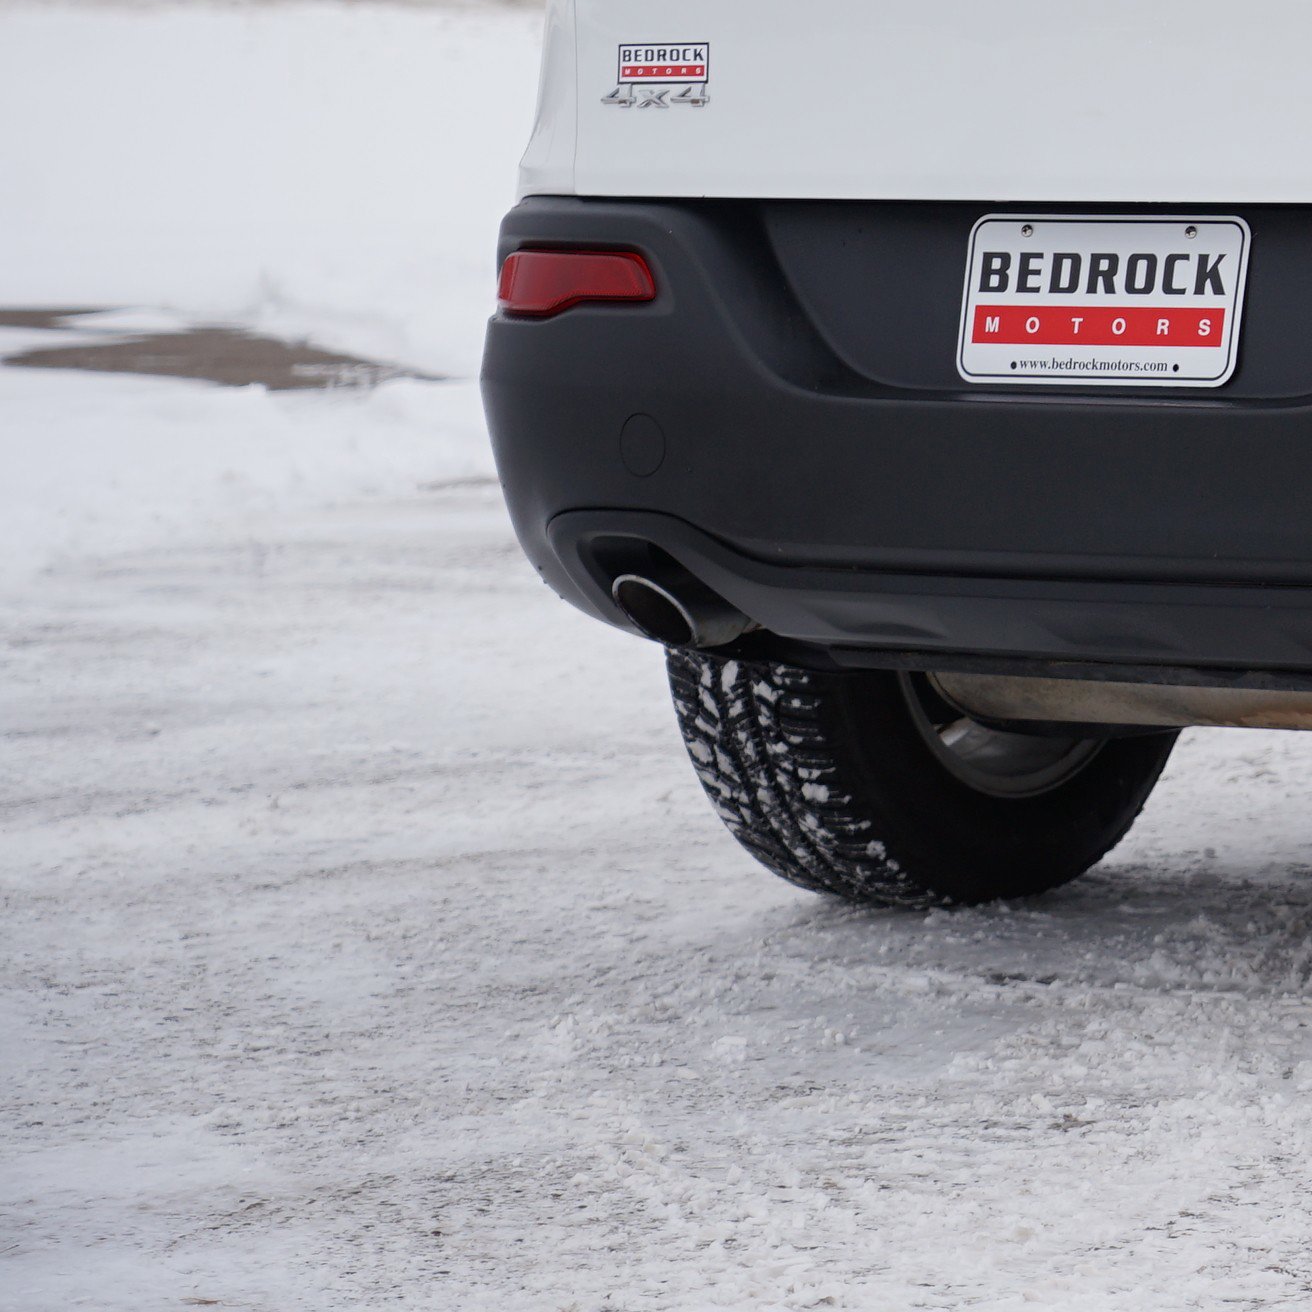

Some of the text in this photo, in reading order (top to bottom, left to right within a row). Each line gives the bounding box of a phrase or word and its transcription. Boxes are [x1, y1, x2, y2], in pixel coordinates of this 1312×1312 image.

[622, 48, 704, 62] BEDROCK
[624, 67, 702, 76] MOTORS
[978, 251, 1227, 296] BEDROCK
[985, 316, 1211, 336] MOTORS
[1019, 357, 1168, 373] www.bedrockmotors.com
